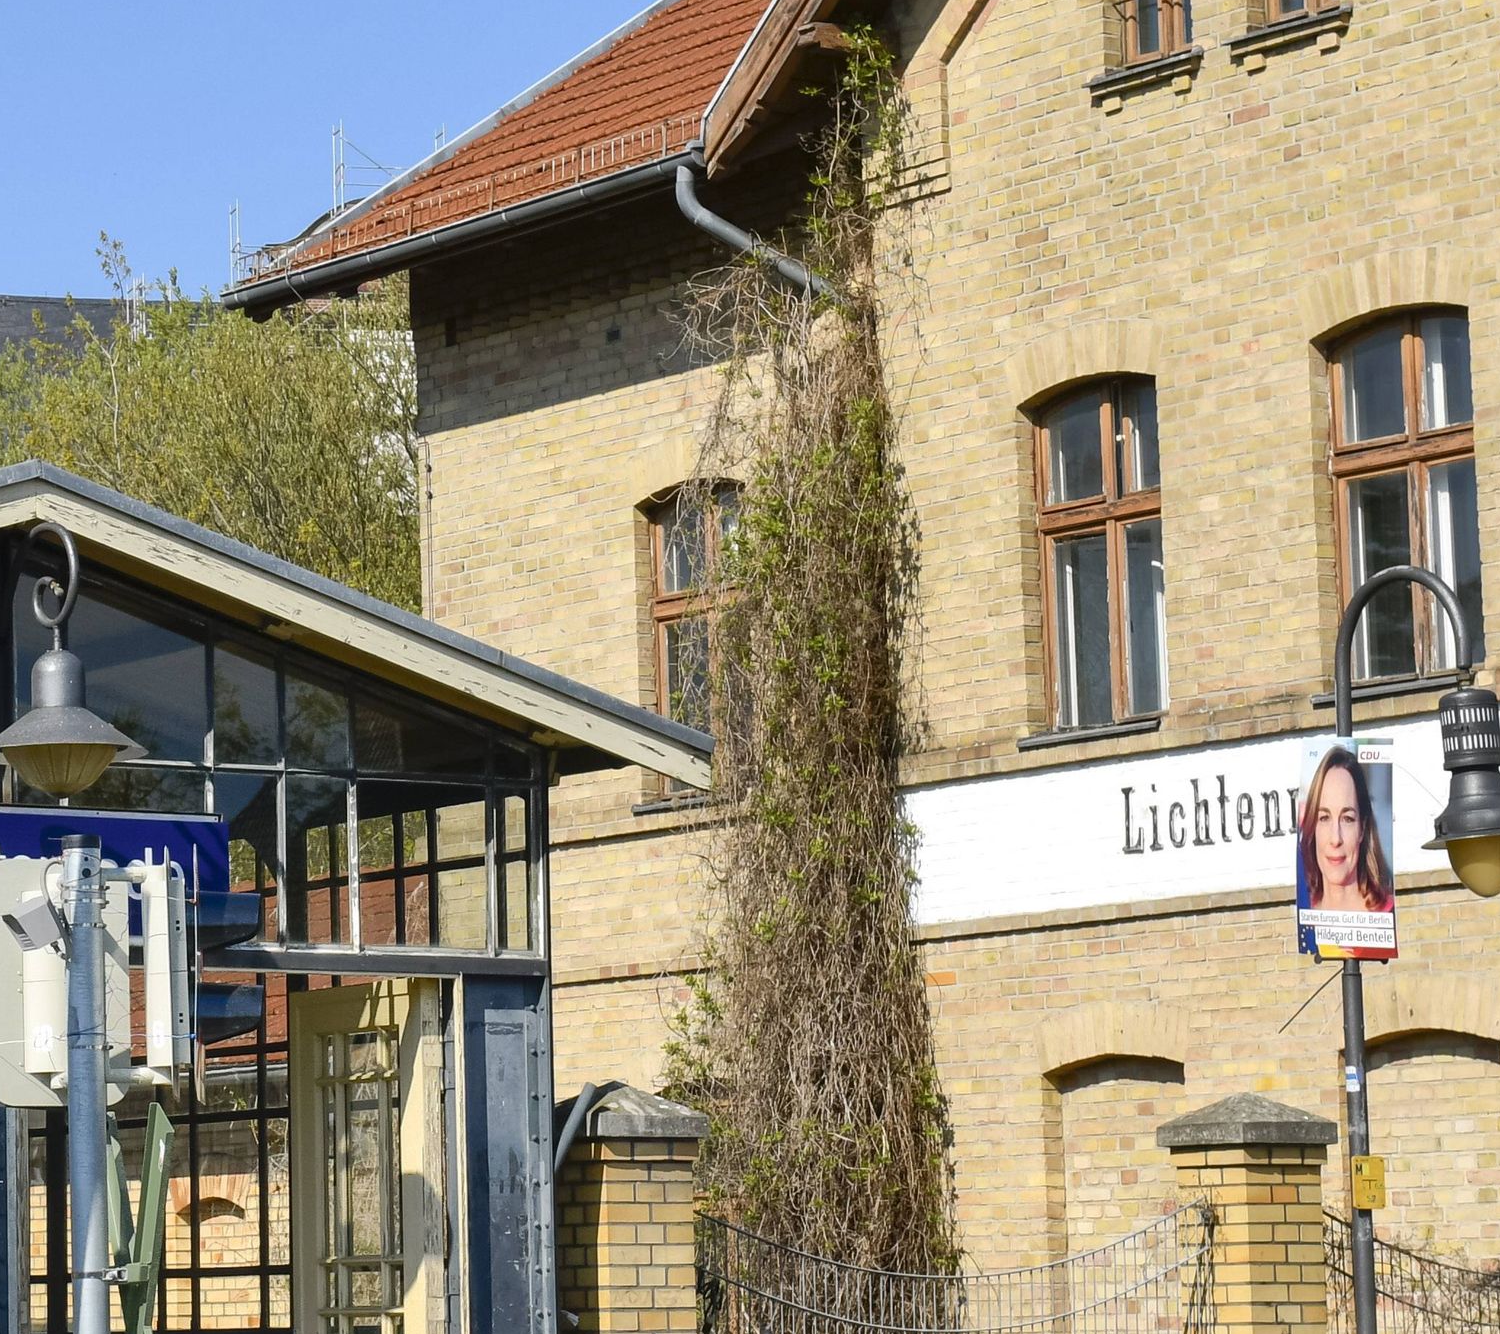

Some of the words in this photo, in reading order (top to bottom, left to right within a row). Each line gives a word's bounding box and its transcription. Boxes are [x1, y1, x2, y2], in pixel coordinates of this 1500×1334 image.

[1359, 751, 1380, 760] CDU
[1342, 914, 1355, 923] Gut
[1356, 914, 1367, 924] für
[1317, 929, 1353, 944] Hildegard
[1356, 930, 1393, 943] Bentele
